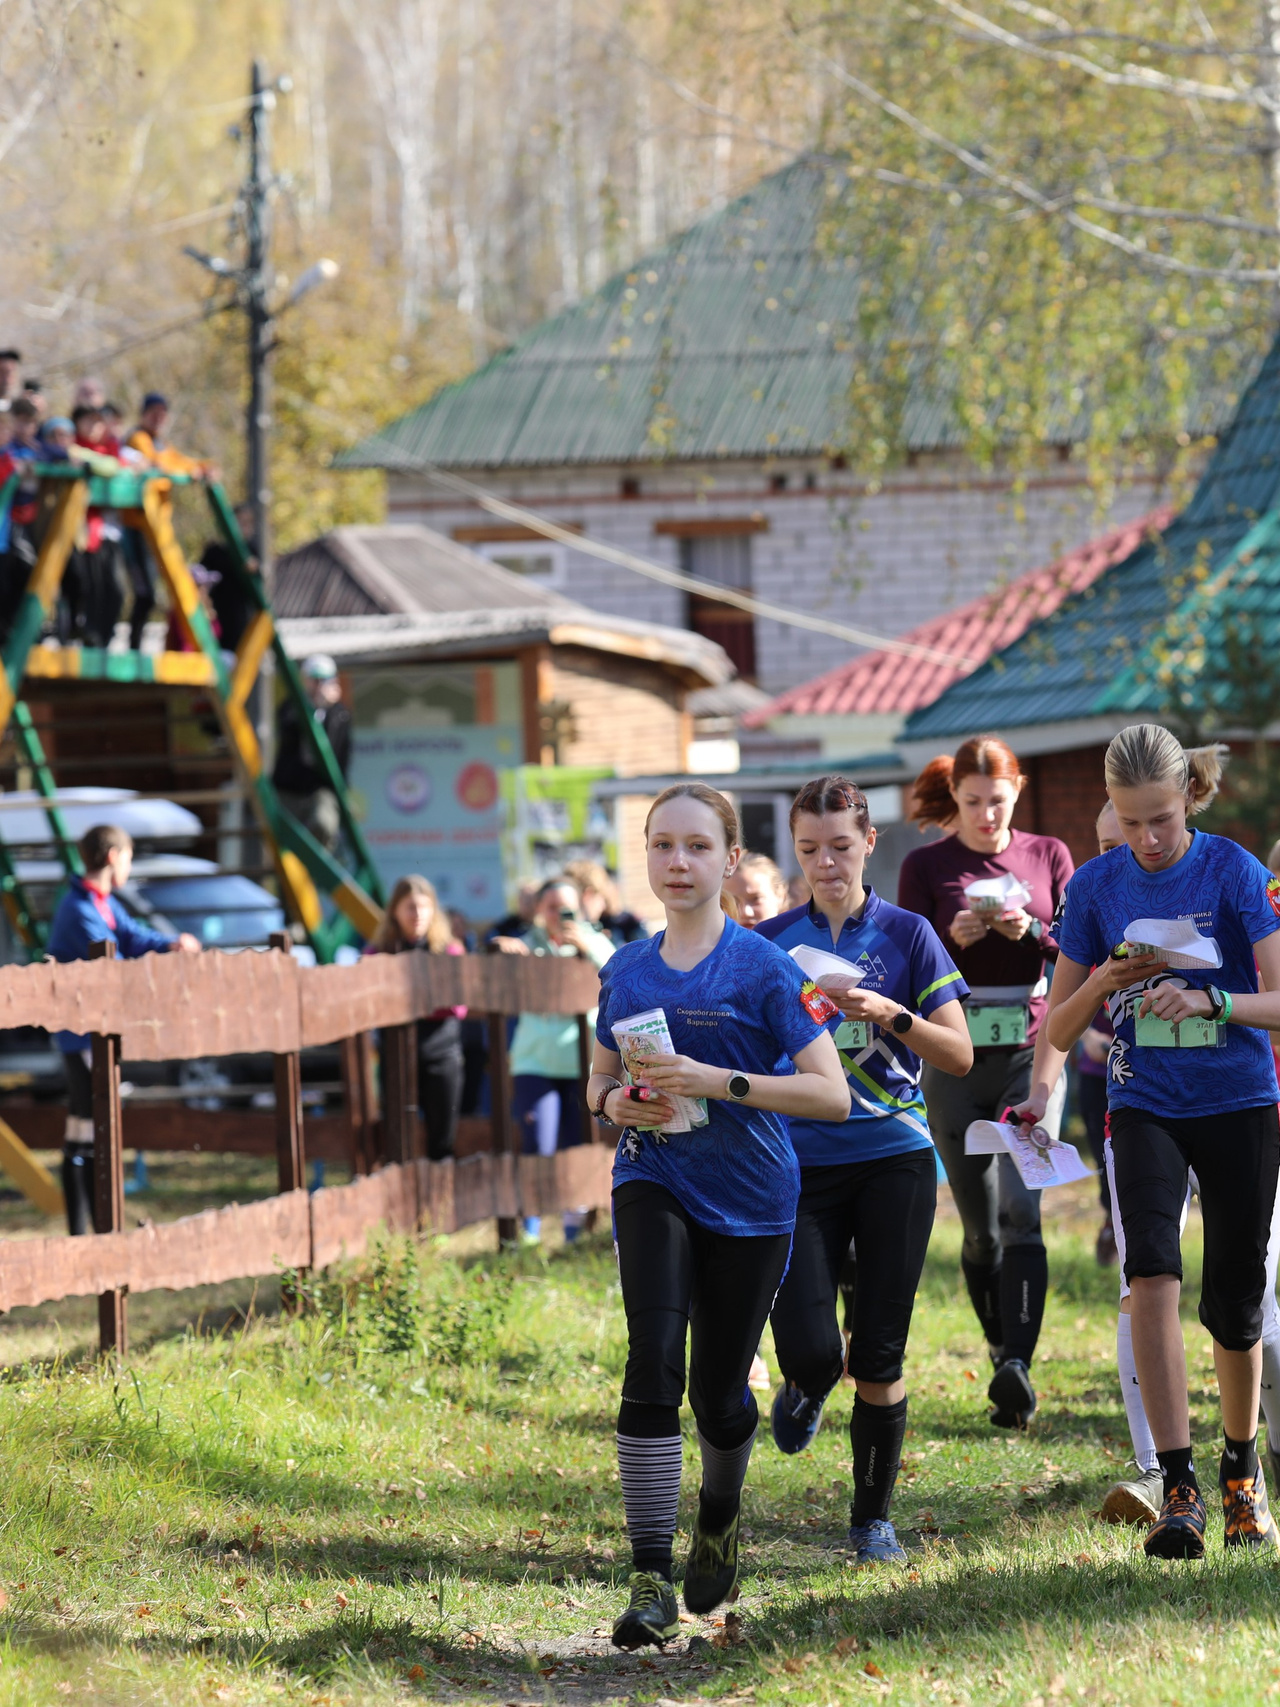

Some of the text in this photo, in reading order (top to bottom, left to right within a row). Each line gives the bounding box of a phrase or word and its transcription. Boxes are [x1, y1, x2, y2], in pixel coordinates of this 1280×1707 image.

[852, 1027, 860, 1045] 2
[990, 1023, 1001, 1043] 3
[1203, 1029, 1209, 1046] 1
